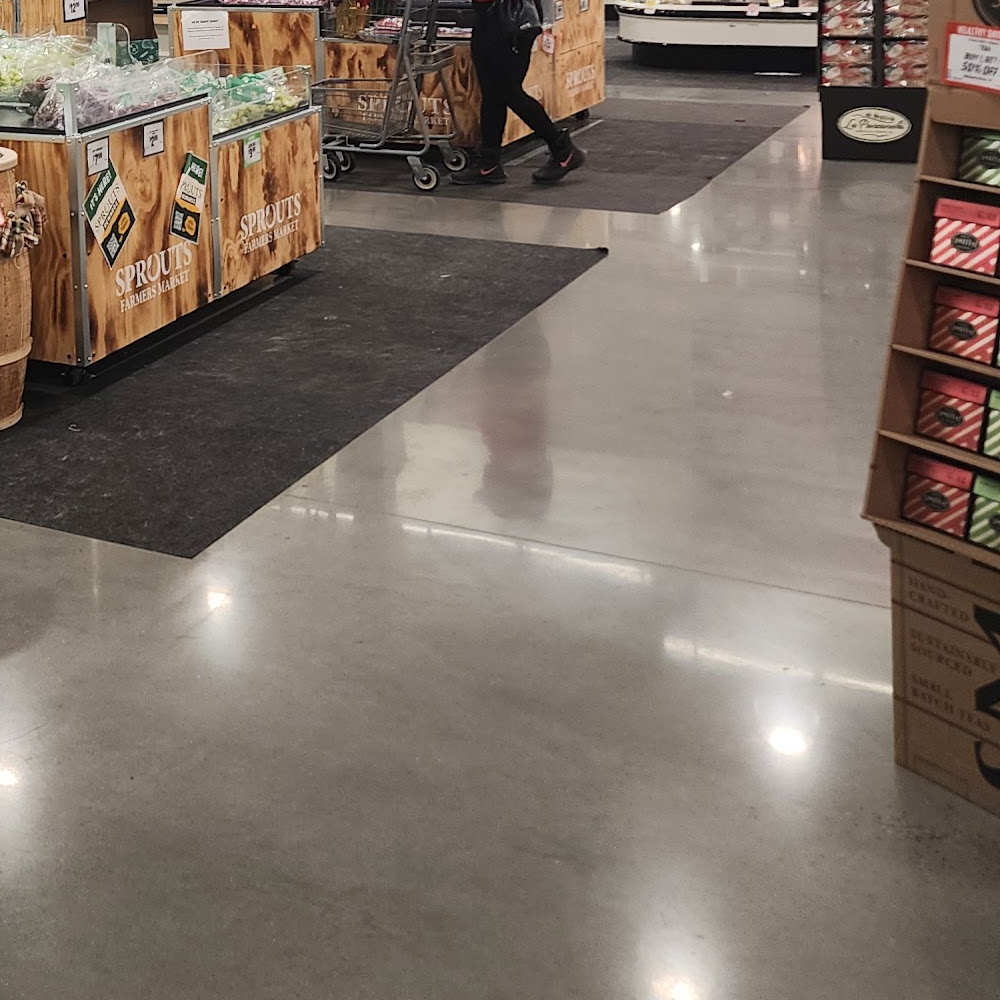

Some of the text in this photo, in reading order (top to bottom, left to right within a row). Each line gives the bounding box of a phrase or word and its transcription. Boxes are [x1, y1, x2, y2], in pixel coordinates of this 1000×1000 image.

[240, 193, 301, 240] SPROUTS
[243, 219, 299, 255] FARMERS MARKET
[115, 241, 193, 297] SPROUTS
[120, 269, 190, 313] FARMERS MARKET
